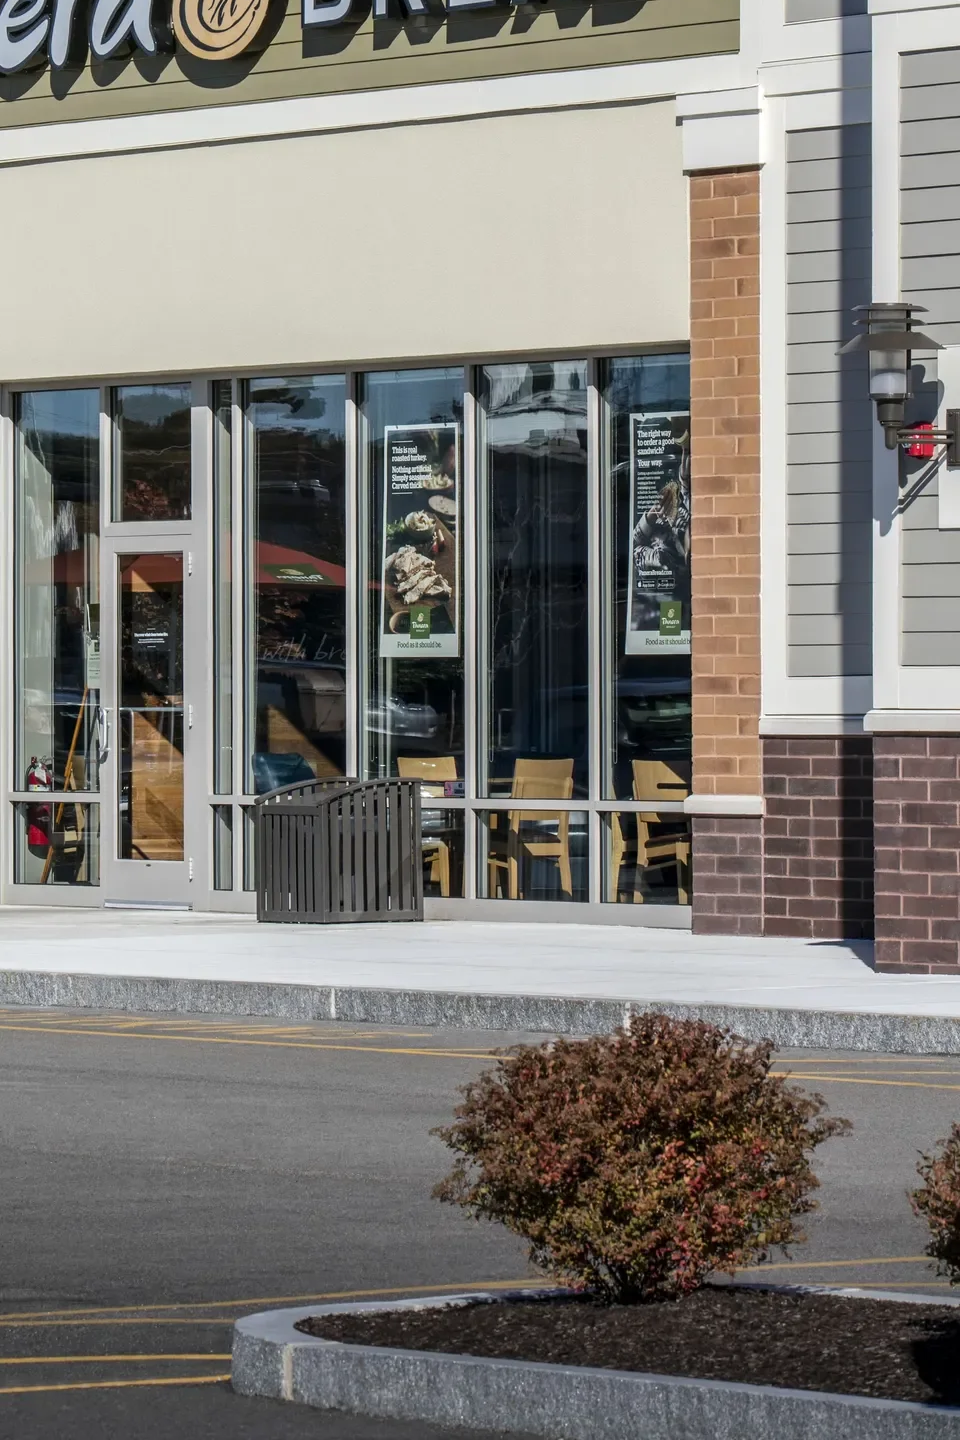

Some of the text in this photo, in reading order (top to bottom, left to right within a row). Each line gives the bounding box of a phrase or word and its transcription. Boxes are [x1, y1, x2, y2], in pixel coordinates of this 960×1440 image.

[637, 430, 671, 439] The right way
[662, 438, 675, 446] good
[392, 446, 403, 454] This
[637, 447, 664, 455] sandwich?
[392, 466, 411, 474] Nothing
